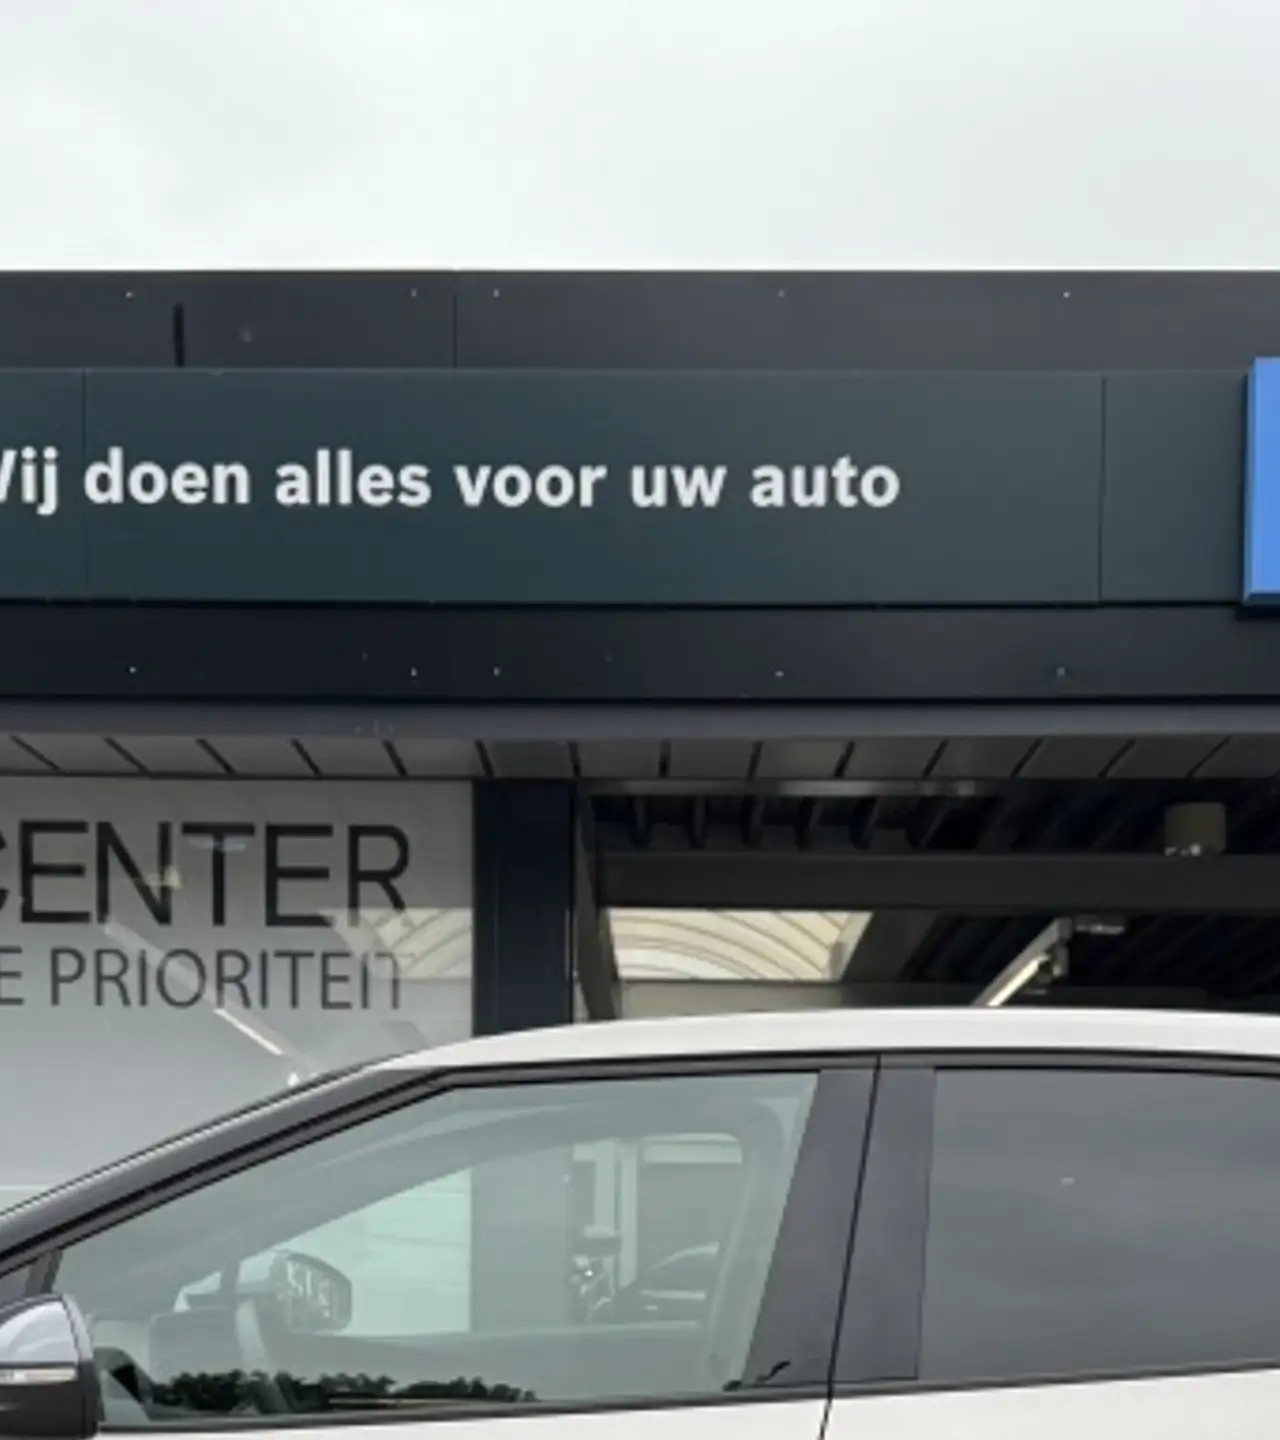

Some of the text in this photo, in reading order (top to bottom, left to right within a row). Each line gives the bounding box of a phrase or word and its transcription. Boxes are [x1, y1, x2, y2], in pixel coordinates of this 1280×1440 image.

[84, 446, 251, 505] doen
[275, 448, 432, 507] alles
[454, 464, 608, 508] voor
[631, 464, 727, 508] uw
[749, 456, 901, 508] auto
[49, 945, 412, 1011] PRIORITEIT
